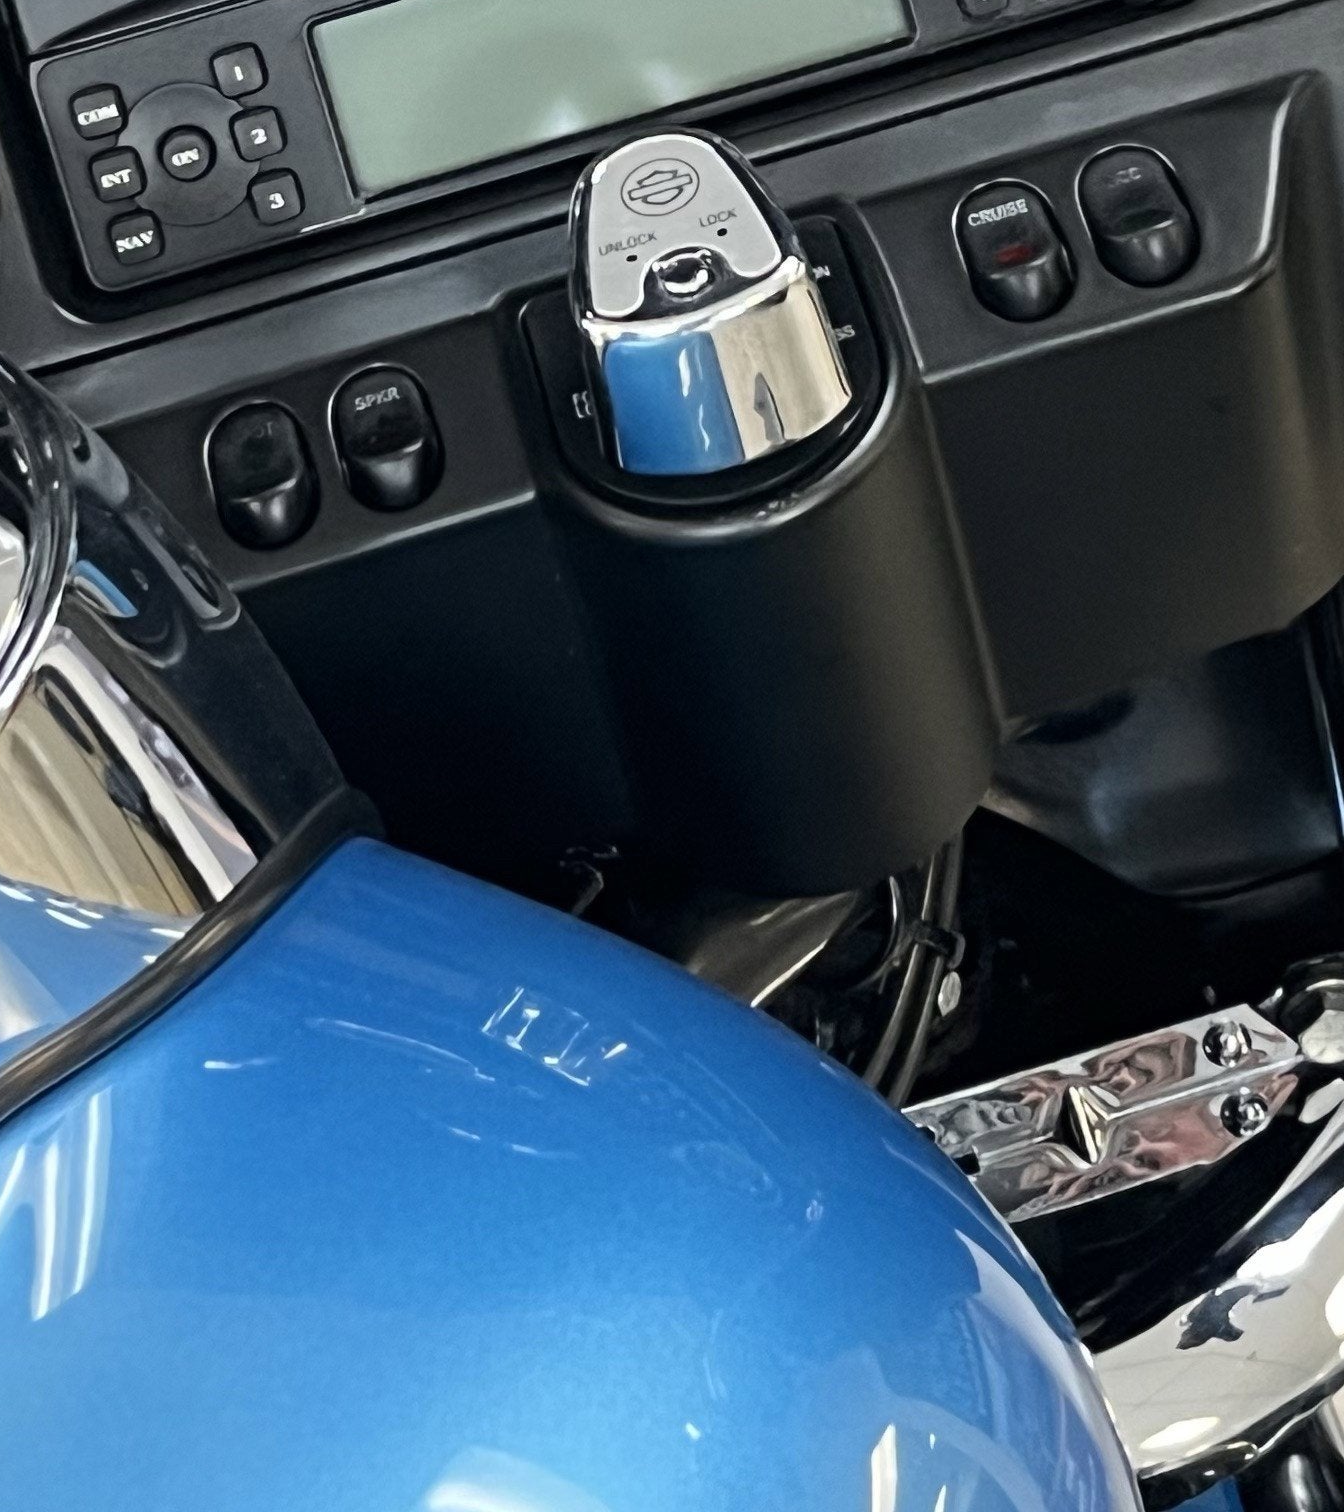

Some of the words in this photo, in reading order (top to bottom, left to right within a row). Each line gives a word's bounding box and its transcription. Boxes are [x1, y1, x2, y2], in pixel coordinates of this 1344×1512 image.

[699, 208, 737, 228] LOCK
[967, 198, 1028, 227] CRUISE
[598, 230, 657, 256] UNLOCK
